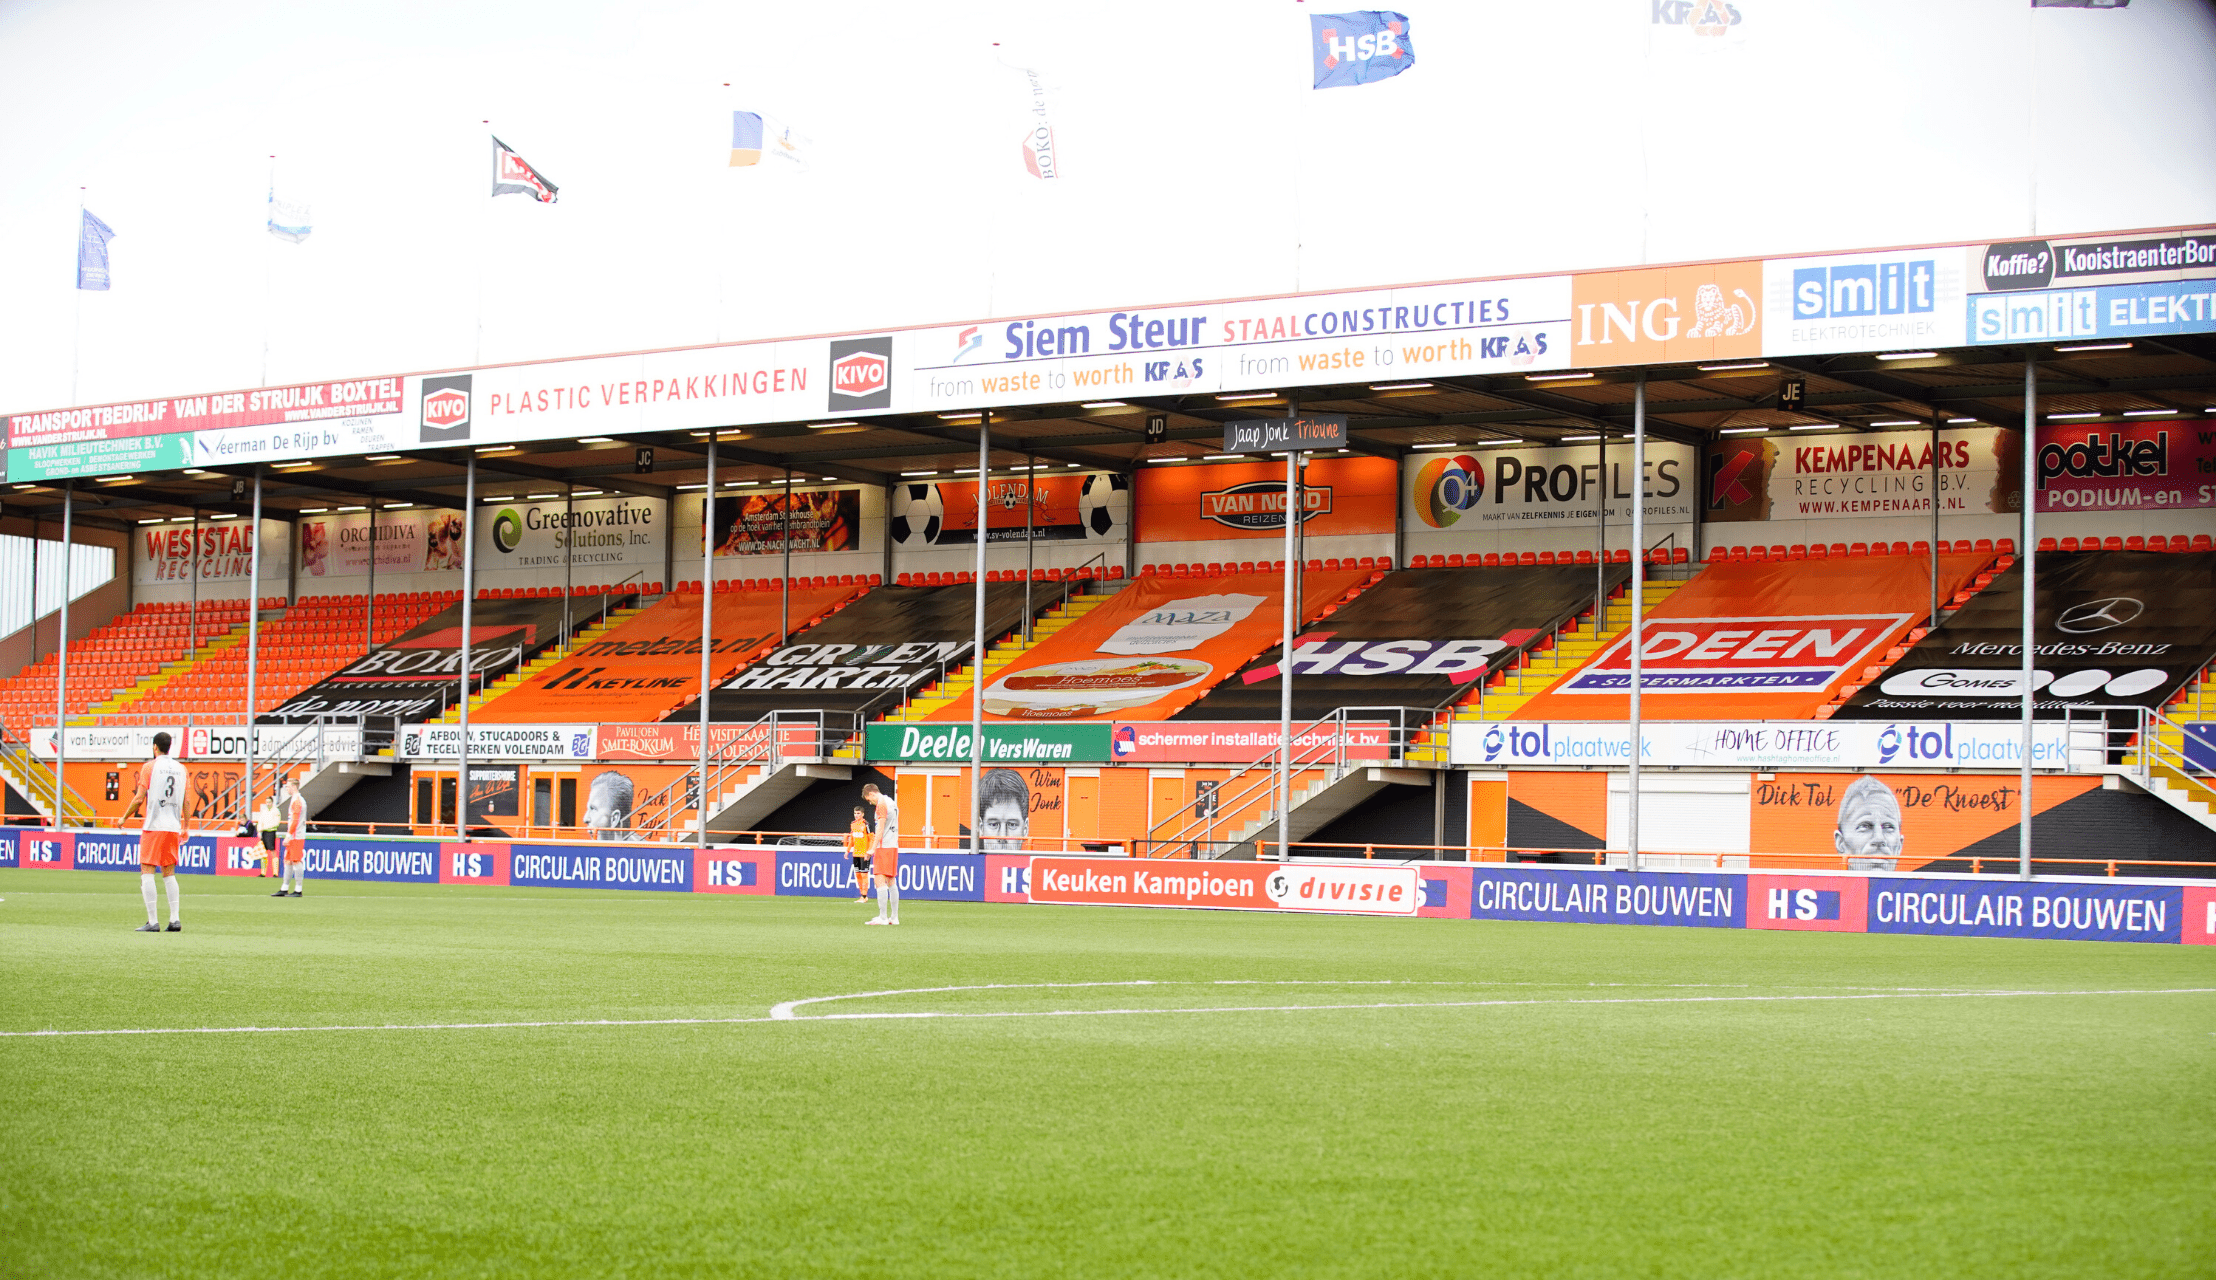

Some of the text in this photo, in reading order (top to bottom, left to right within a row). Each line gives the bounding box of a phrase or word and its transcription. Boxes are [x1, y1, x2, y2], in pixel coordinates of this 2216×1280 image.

[1329, 31, 1398, 61] HSB
[1988, 251, 2049, 277] Koffie?
[2064, 239, 2216, 272] KooistraenterBor
[1797, 264, 1930, 315] smit
[1223, 298, 1510, 343] STAALCONSTRUCTIES
[1577, 297, 1681, 346] ING
[1981, 292, 2216, 336] smit ELEKT
[1005, 312, 1206, 359] Siem Steur
[1792, 321, 1935, 342] ELEKTROTECHNIEK
[1239, 352, 1290, 376] from
[1299, 346, 1365, 371] waste
[1374, 346, 1394, 367] to
[1402, 337, 1472, 364] worth
[835, 362, 883, 386] KIVO
[930, 374, 974, 398] from
[981, 370, 1041, 393] waste
[1047, 369, 1067, 389] to
[1073, 362, 1133, 387] worth
[489, 367, 808, 417] PLASTIC VERPAKKINGEN
[1782, 383, 1801, 401] JE
[12, 377, 401, 436] TRANSPORTBEDRIJF VAN DER STRUIJK BOXTEL
[284, 401, 399, 422] WWW.VANDERSTRUIJK.NL
[426, 395, 466, 419] KIVO
[352, 426, 374, 434] RAMEN
[1148, 418, 1164, 435] JD
[1230, 419, 1340, 450] Jaap Jonk Tribune
[28, 436, 164, 460] HAVIK MILIEUTECHNIEK B.V.
[273, 435, 289, 450] De
[294, 431, 319, 451] Rijp
[323, 430, 339, 445] bv
[638, 450, 651, 466] JC
[1795, 440, 1970, 474] KEMPENAARS
[2037, 431, 2168, 490] patkel
[233, 480, 245, 494] JB
[1795, 473, 1970, 496] RECYCLING B.V.
[1212, 495, 1254, 513] VAN
[2049, 487, 2182, 507] PODIUM-en
[526, 500, 652, 530] Greenovative
[745, 511, 779, 522] Amsterdam
[1243, 514, 1287, 524] REIZEN
[1482, 510, 1575, 522] MAAKT VAN ZELFKENNIS JE
[628, 527, 651, 545] Inc.
[730, 525, 738, 533] op
[739, 523, 746, 531] de
[747, 522, 760, 531] hoek
[773, 521, 783, 530] het
[739, 539, 820, 551] WWW.DE-NACHWACHT.NL
[518, 553, 559, 565] TRADING
[571, 551, 623, 564] RECYCLING
[1624, 627, 1868, 662] DEEN
[1949, 642, 2173, 656] Mercedes-Benz
[1277, 639, 1508, 676] HSB
[586, 676, 694, 690] KEYLINE
[1057, 675, 1143, 685] Hoemoes
[1920, 672, 2017, 689] GOMES
[1021, 709, 1074, 718] Hoemoes
[70, 734, 129, 746] van Bruxvoort
[210, 728, 260, 755] bond
[479, 730, 561, 743] STUCADOORS &
[616, 726, 659, 738] PAVILJOEN
[1138, 731, 1208, 746] schermer
[1360, 732, 1380, 746] bv
[1509, 724, 1550, 758] tol
[1714, 728, 1840, 751] HOME OFFICE
[1907, 722, 1954, 760] tol
[504, 743, 564, 754] VOLENDAM
[989, 738, 1073, 759] VersWaren
[1736, 753, 1840, 763] www.hashtaghomeoffice.nl
[165, 776, 175, 798] 3
[1029, 768, 1062, 789] Wim
[1029, 791, 1062, 813] Jonk
[1757, 782, 1836, 806] Dick Tol
[30, 840, 53, 862] HS
[228, 846, 254, 870] HS
[363, 850, 433, 875] BOUWEN
[452, 853, 482, 877] HS
[514, 854, 684, 884] CIRCULAIR BOUWEN
[708, 860, 742, 886] HS
[1042, 868, 1128, 894] Keuken
[1133, 869, 1255, 901] Kampioen
[1300, 876, 1404, 904] divisie
[1478, 879, 1733, 918] CIRCULAIR BOUWEN
[1768, 888, 1819, 921] HS
[1876, 890, 2023, 927] CIRCULAIR
[2032, 896, 2166, 932] BOUWEN
